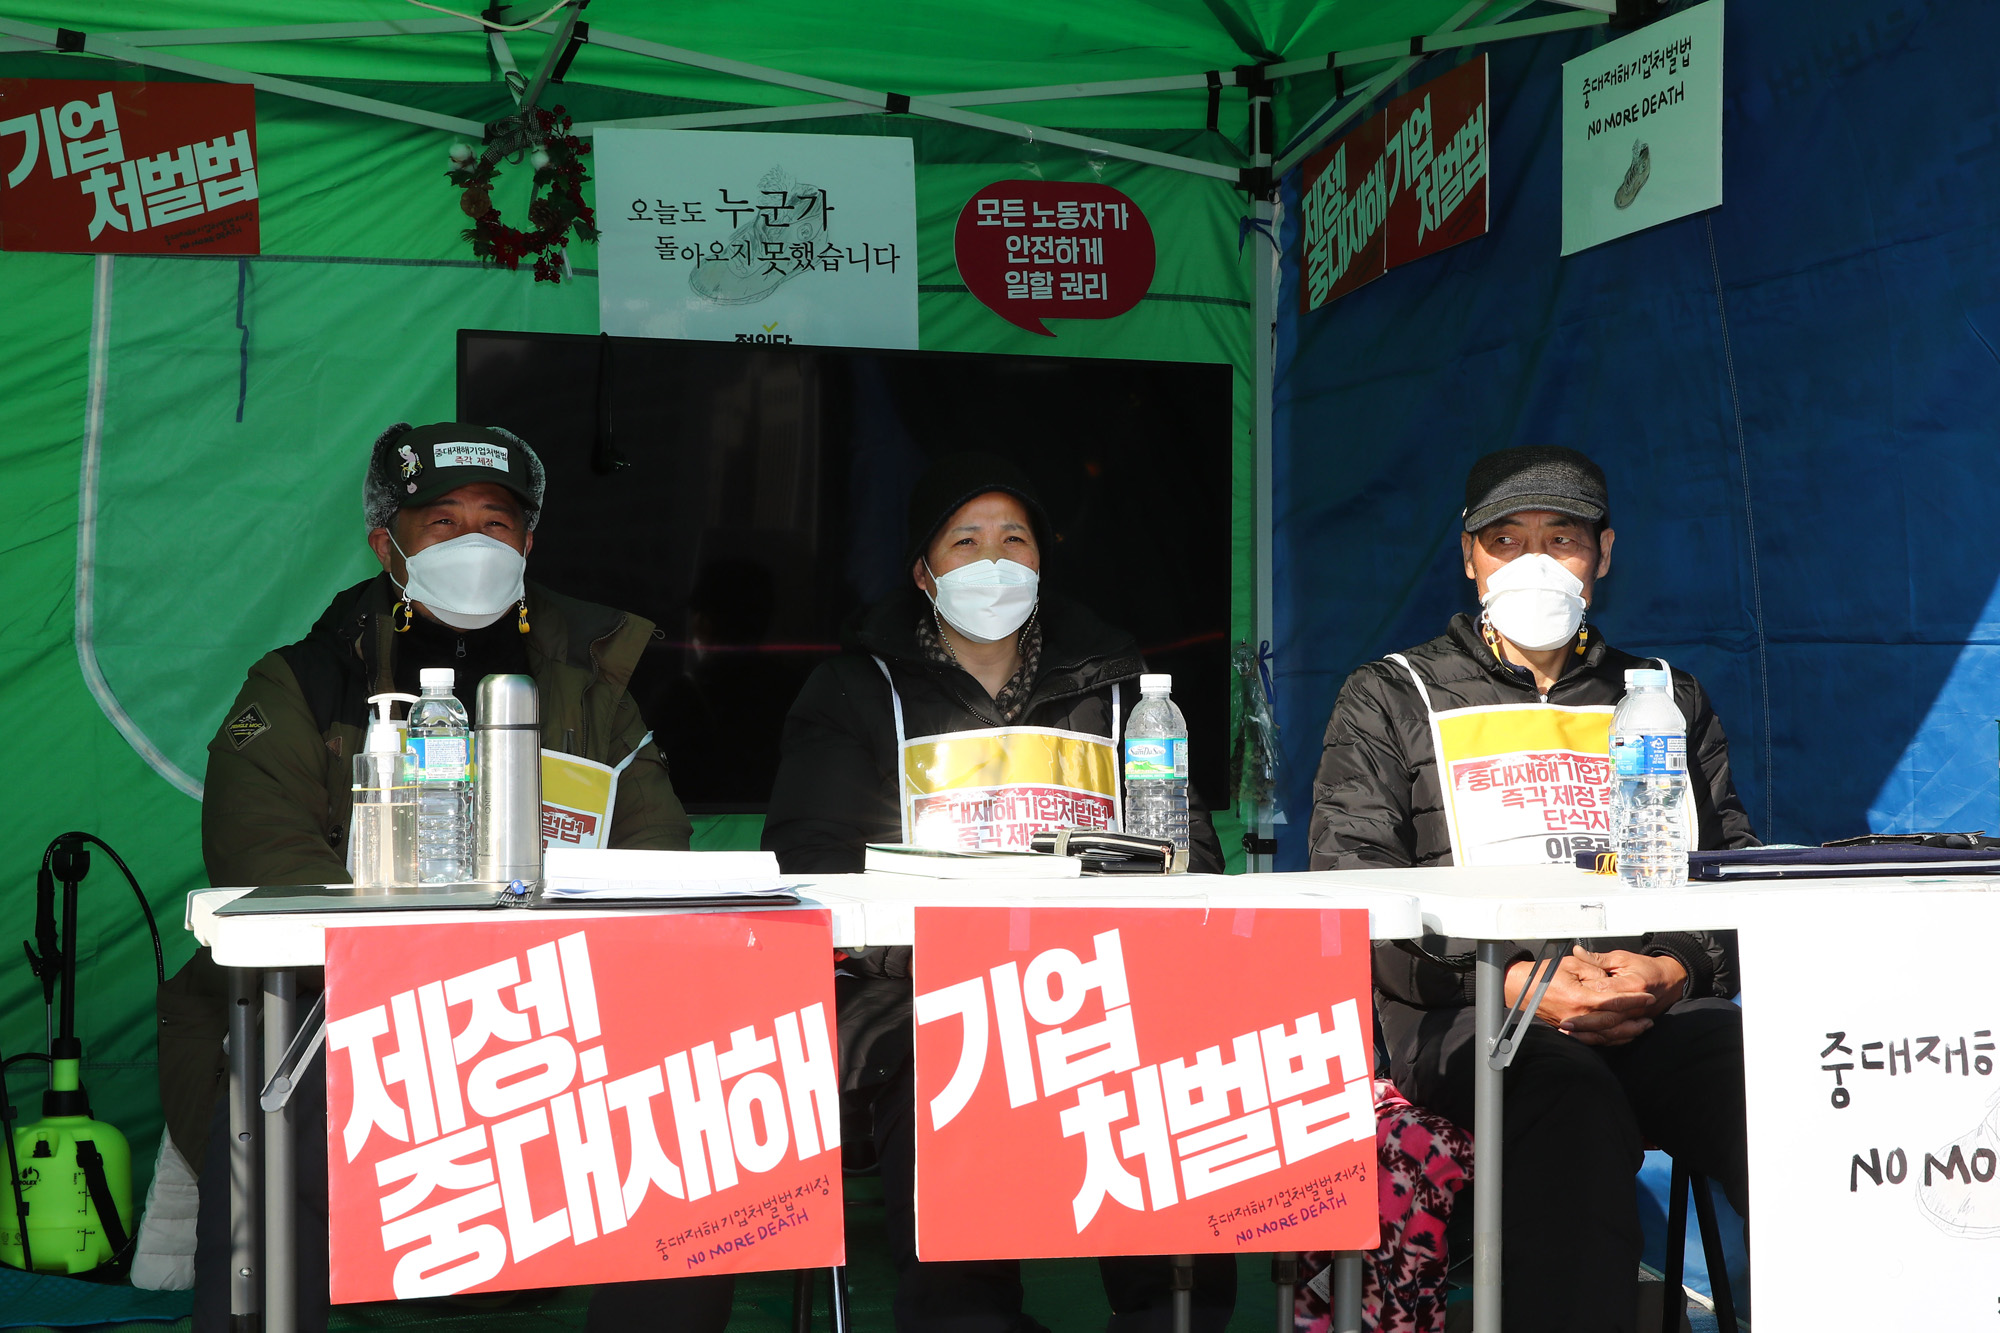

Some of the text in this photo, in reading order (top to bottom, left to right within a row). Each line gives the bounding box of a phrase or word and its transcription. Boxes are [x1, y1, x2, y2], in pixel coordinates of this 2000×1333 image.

[1583, 36, 1691, 109] 중대재해기업처벌법
[0, 91, 125, 189] 기업
[1587, 81, 1684, 140] NO MORE DEATH
[1386, 92, 1433, 207] 기업
[1416, 102, 1486, 247] 처벌법
[80, 129, 259, 242] 처벌법
[627, 188, 835, 231] 오늘도 누군가
[977, 199, 1129, 231] 모든 노동자가
[655, 235, 900, 276] 돌아오지 못했습니다
[1005, 235, 1104, 265] 안전하게
[1308, 152, 1387, 311] 중대재해
[1004, 270, 1108, 300] 일할 권리
[1501, 786, 1548, 809] 즉각
[1550, 785, 1597, 808] 제정
[957, 824, 1003, 848] 즉각
[326, 930, 608, 1164] 제정!
[914, 928, 1140, 1132] 기업
[1059, 998, 1377, 1234] 처벌법
[375, 1001, 842, 1300] 중대재해
[1850, 1146, 1907, 1192] NO
[687, 1207, 809, 1270] NO MORE DEATH
[1236, 1192, 1348, 1246] NO MORE DEATH
